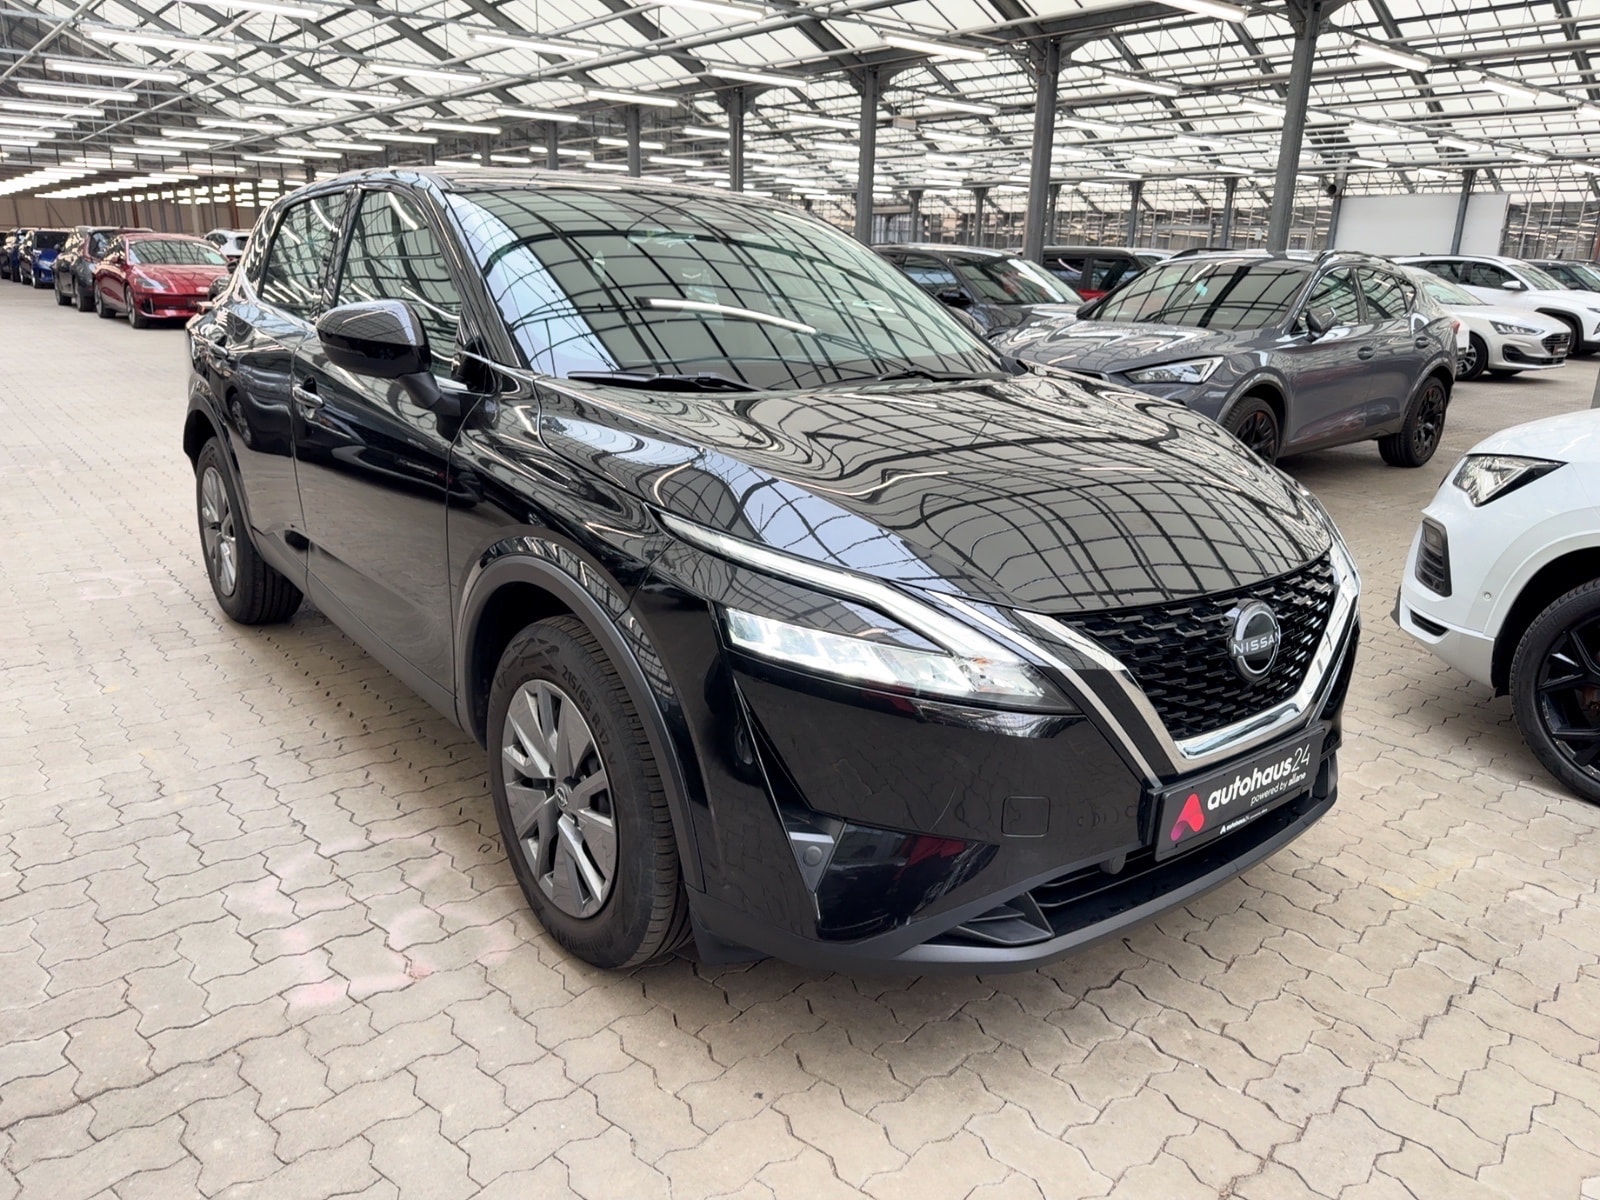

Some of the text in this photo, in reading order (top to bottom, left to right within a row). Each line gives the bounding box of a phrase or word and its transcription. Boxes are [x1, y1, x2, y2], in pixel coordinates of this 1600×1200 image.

[1233, 631, 1280, 655] NISSAN
[561, 664, 592, 713] 215/65
[1207, 743, 1311, 811] autohaus24
[1250, 781, 1279, 807] powered
[1279, 781, 1289, 792] by
